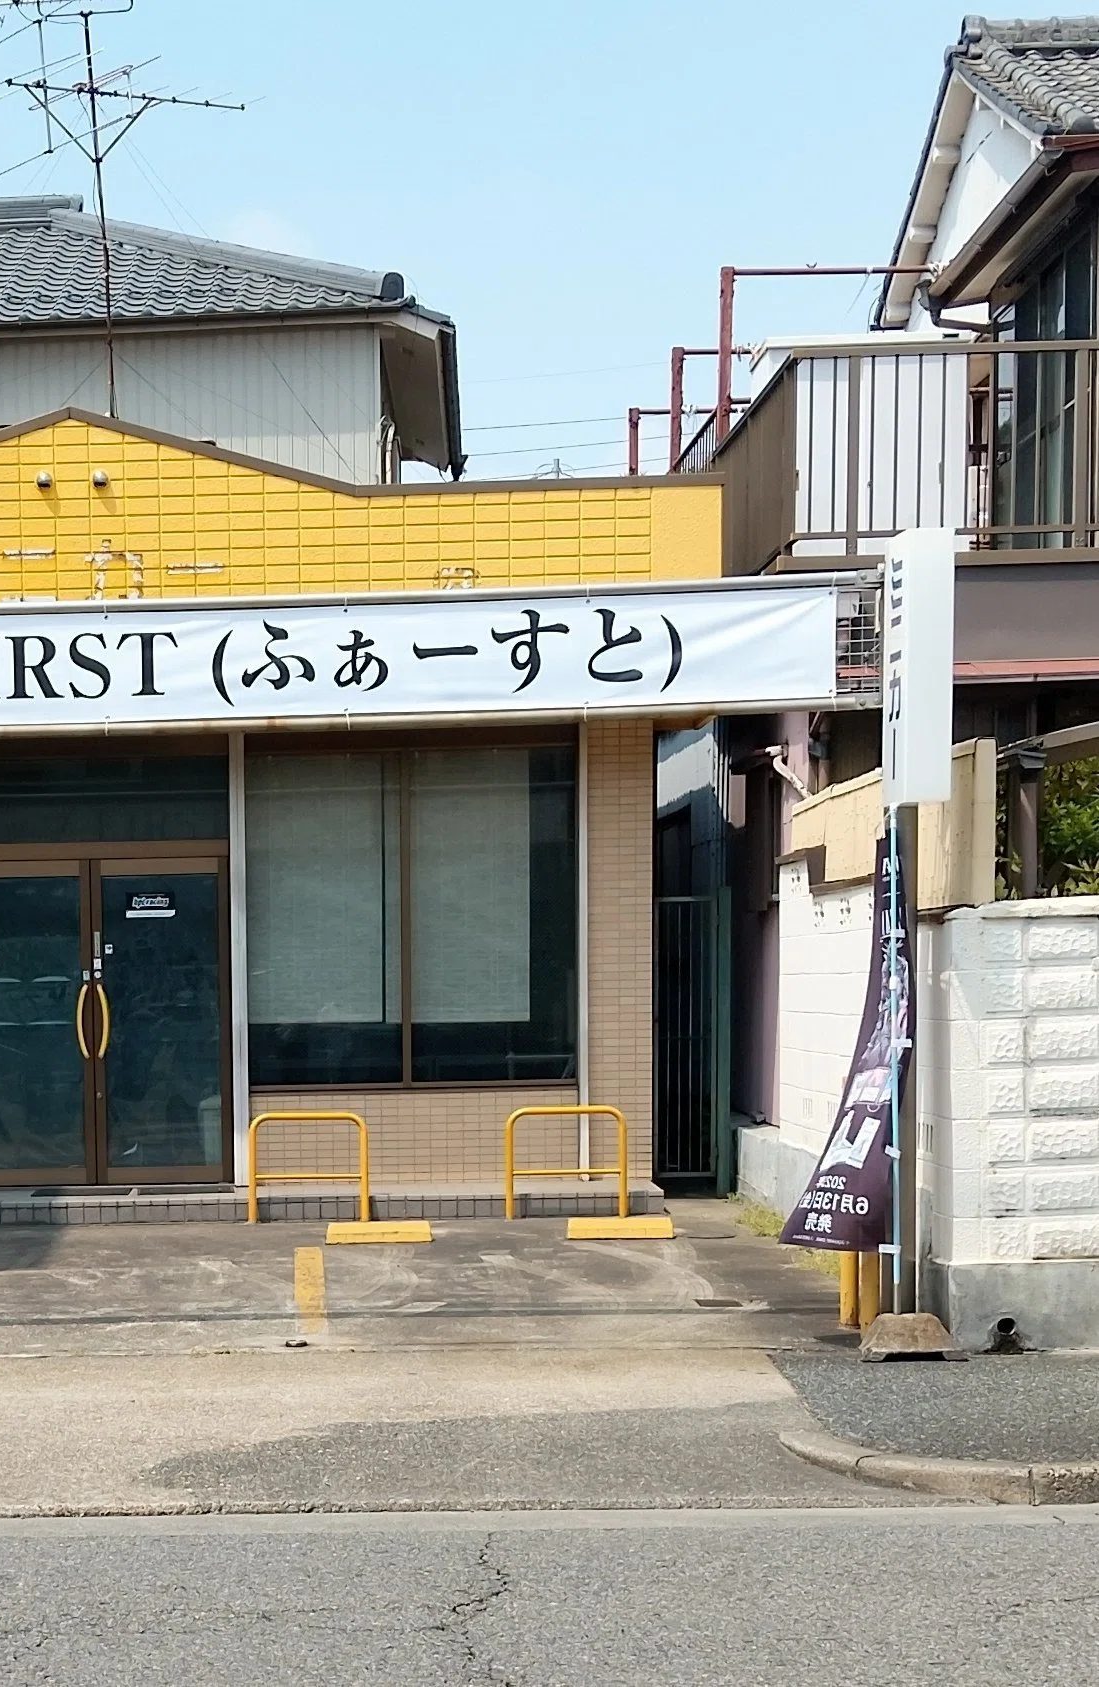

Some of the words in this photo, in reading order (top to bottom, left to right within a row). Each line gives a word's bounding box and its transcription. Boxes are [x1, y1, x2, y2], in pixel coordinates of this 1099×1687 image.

[213, 609, 683, 709] (ふぁーすと)
